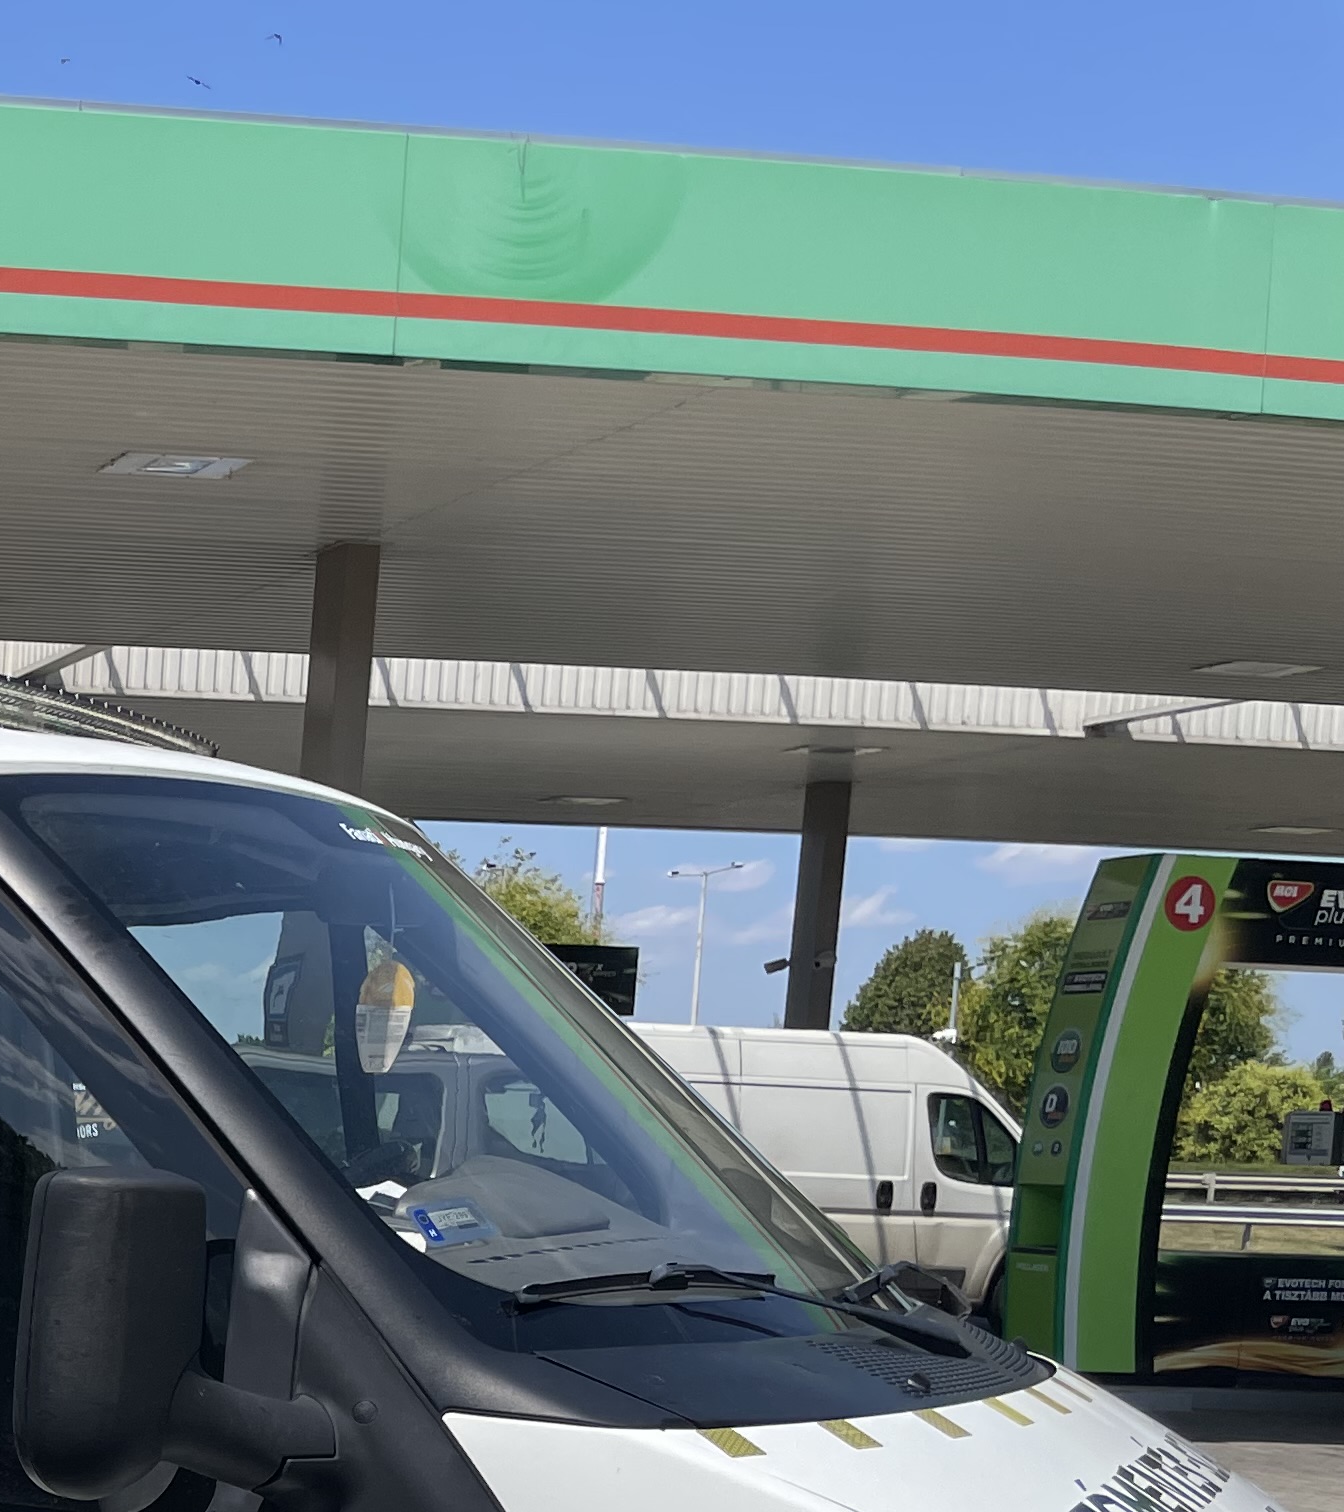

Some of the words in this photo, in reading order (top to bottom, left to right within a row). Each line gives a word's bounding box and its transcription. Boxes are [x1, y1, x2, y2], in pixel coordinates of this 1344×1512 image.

[1174, 883, 1205, 924] 4
[1277, 1278, 1326, 1289] EVOTECH
[1262, 1290, 1272, 1300] A
